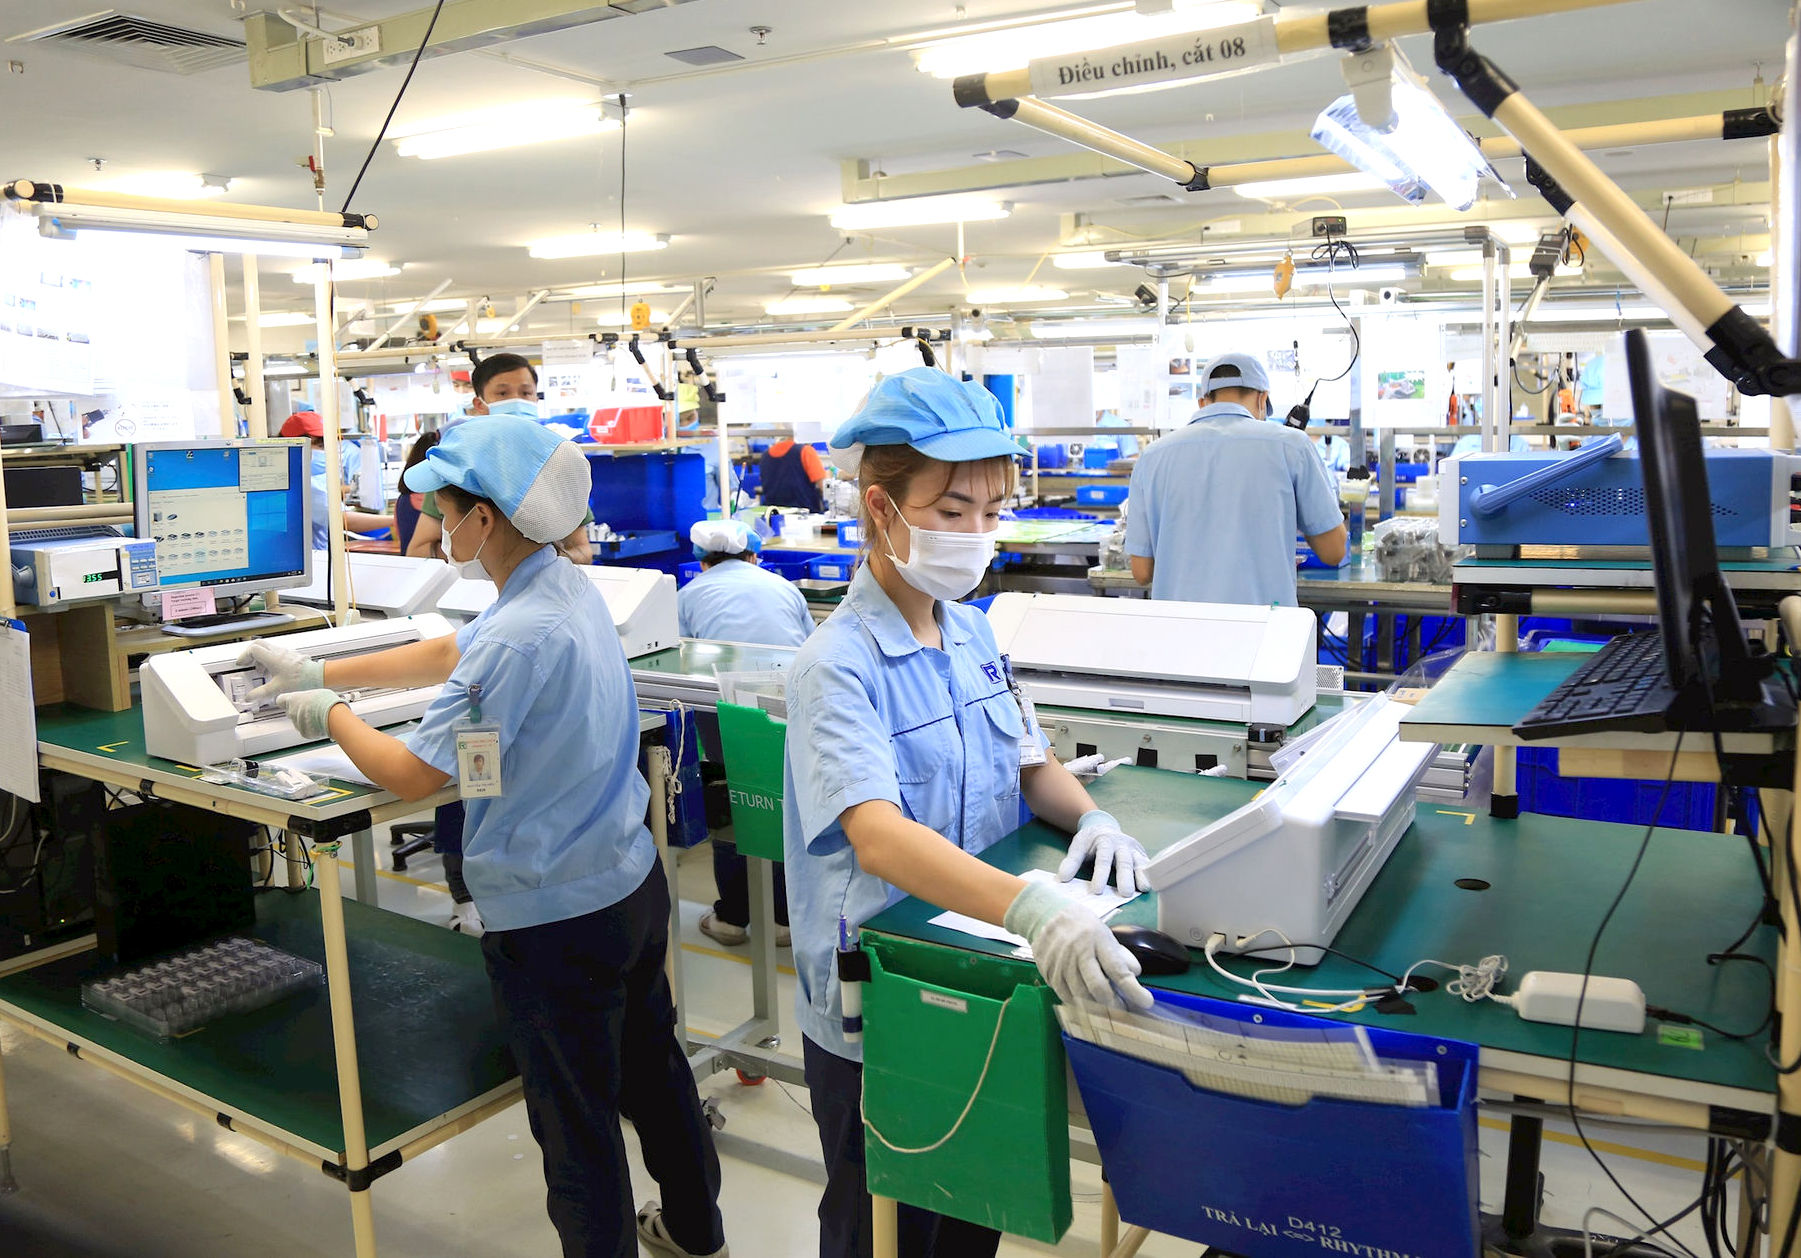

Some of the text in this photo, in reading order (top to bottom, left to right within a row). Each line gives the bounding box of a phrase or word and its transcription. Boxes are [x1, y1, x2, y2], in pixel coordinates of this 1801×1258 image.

[1058, 57, 1105, 85] Điều
[1182, 37, 1214, 66] cắt
[1220, 37, 1246, 59] 08
[1201, 1206, 1242, 1227] TRẢ
[1244, 1217, 1279, 1236] LẠI
[1288, 1216, 1342, 1238] D412
